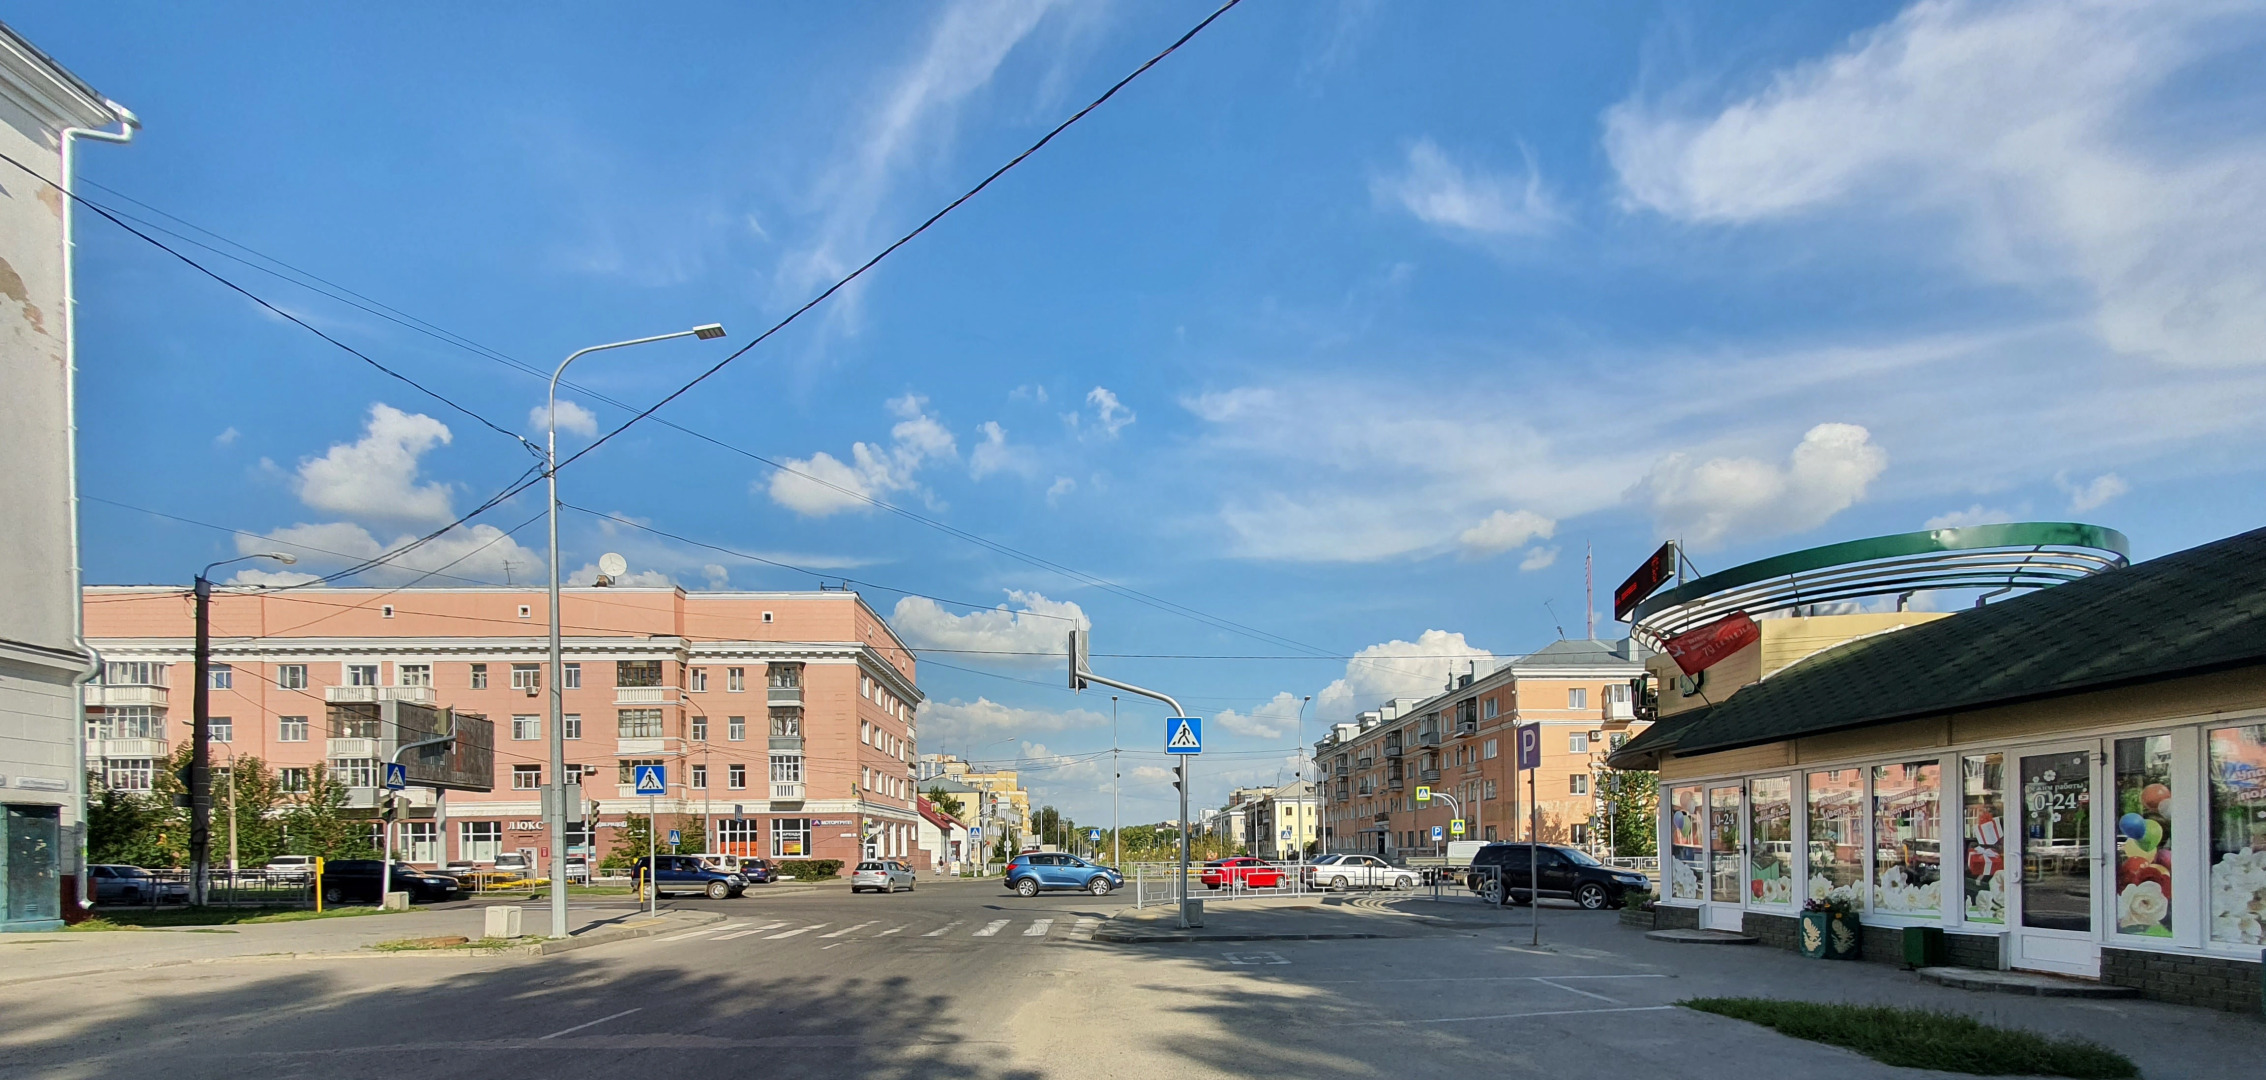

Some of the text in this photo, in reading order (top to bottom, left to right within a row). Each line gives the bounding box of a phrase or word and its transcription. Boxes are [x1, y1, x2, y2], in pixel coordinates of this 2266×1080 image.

[1523, 729, 1535, 764] P
[2034, 793, 2076, 811] 0-24
[507, 821, 544, 831] ЛЮКС
[1714, 813, 1735, 825] 0-24
